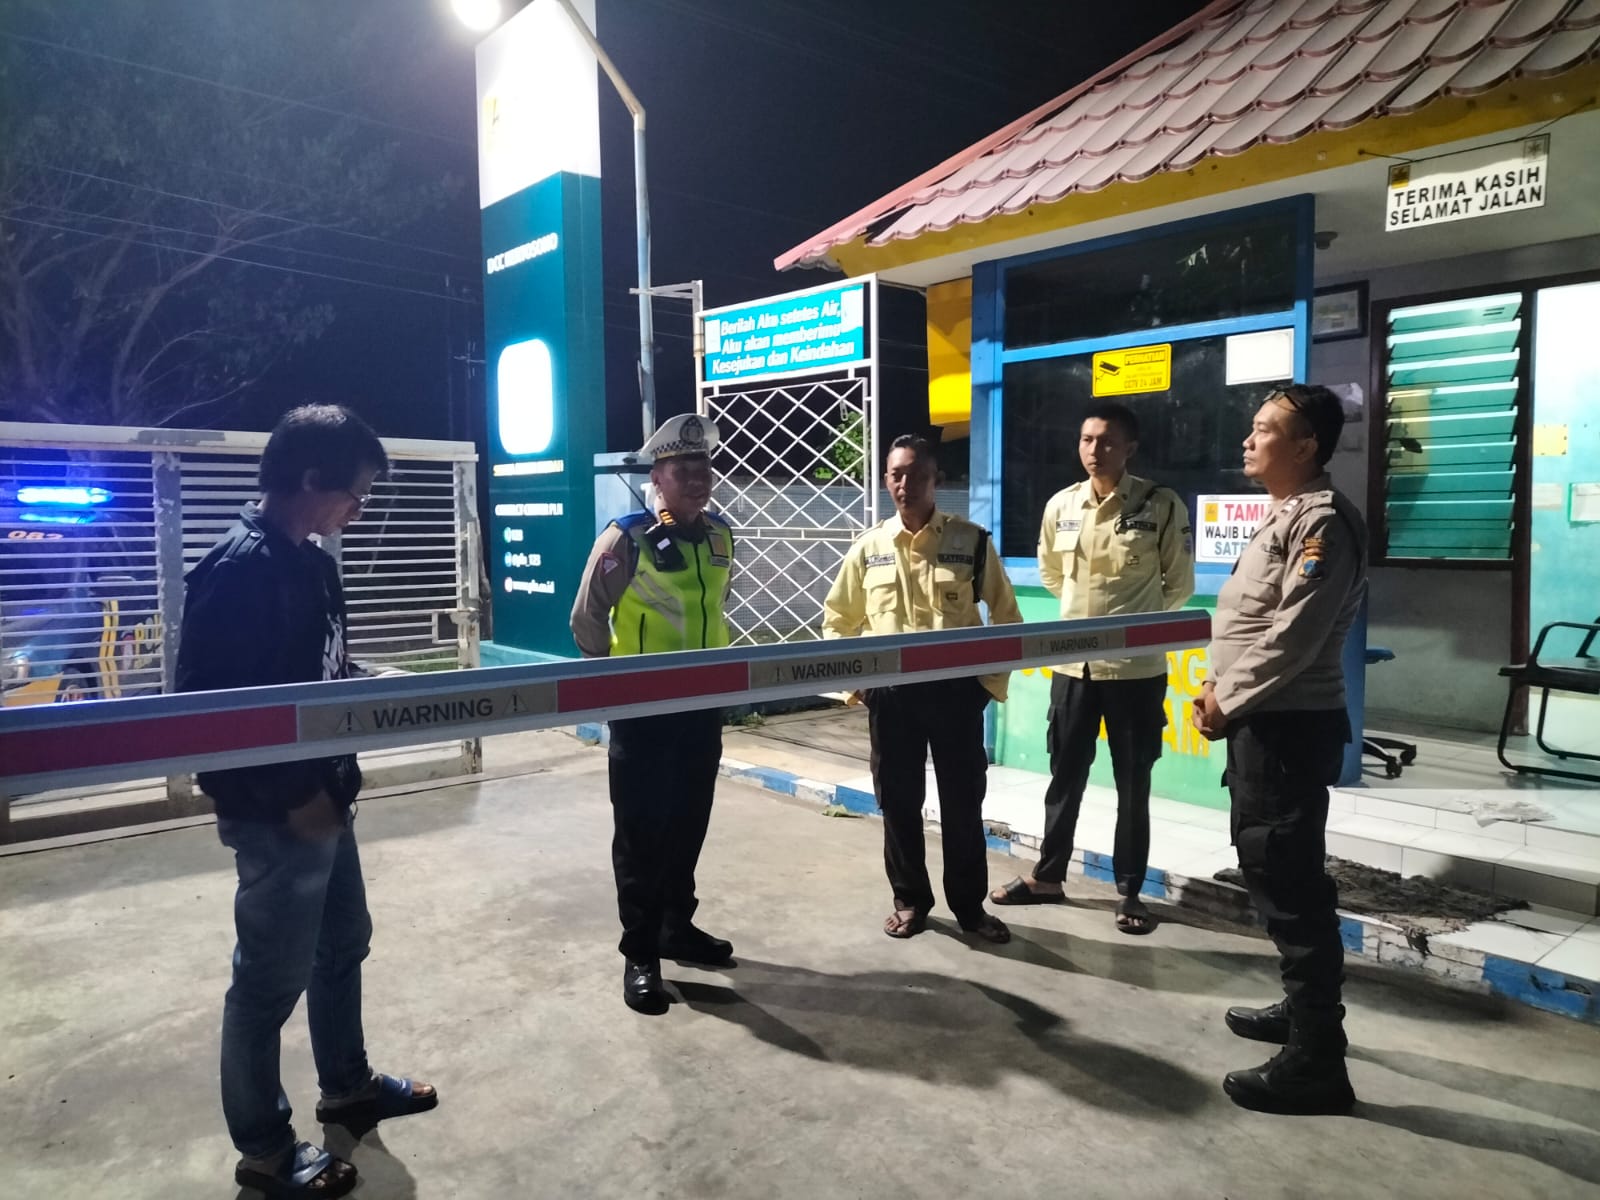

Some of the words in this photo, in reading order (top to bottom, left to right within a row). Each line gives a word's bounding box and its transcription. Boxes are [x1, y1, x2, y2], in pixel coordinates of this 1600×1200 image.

[1394, 180, 1467, 208] TERIMA
[1475, 166, 1540, 193] KASIH
[1390, 197, 1473, 226] SELAMAT
[1479, 185, 1542, 211] JALAN
[720, 316, 755, 336] Berilah
[757, 312, 780, 329] Aku
[711, 356, 765, 376] Kesejukan
[767, 350, 789, 368] dan
[790, 341, 855, 364] Keindahan
[721, 338, 742, 355] Aku
[1205, 525, 1239, 539] WAJIB
[1049, 636, 1099, 652] WARNING
[791, 659, 863, 681] WARNING
[373, 698, 494, 729] WARNING
